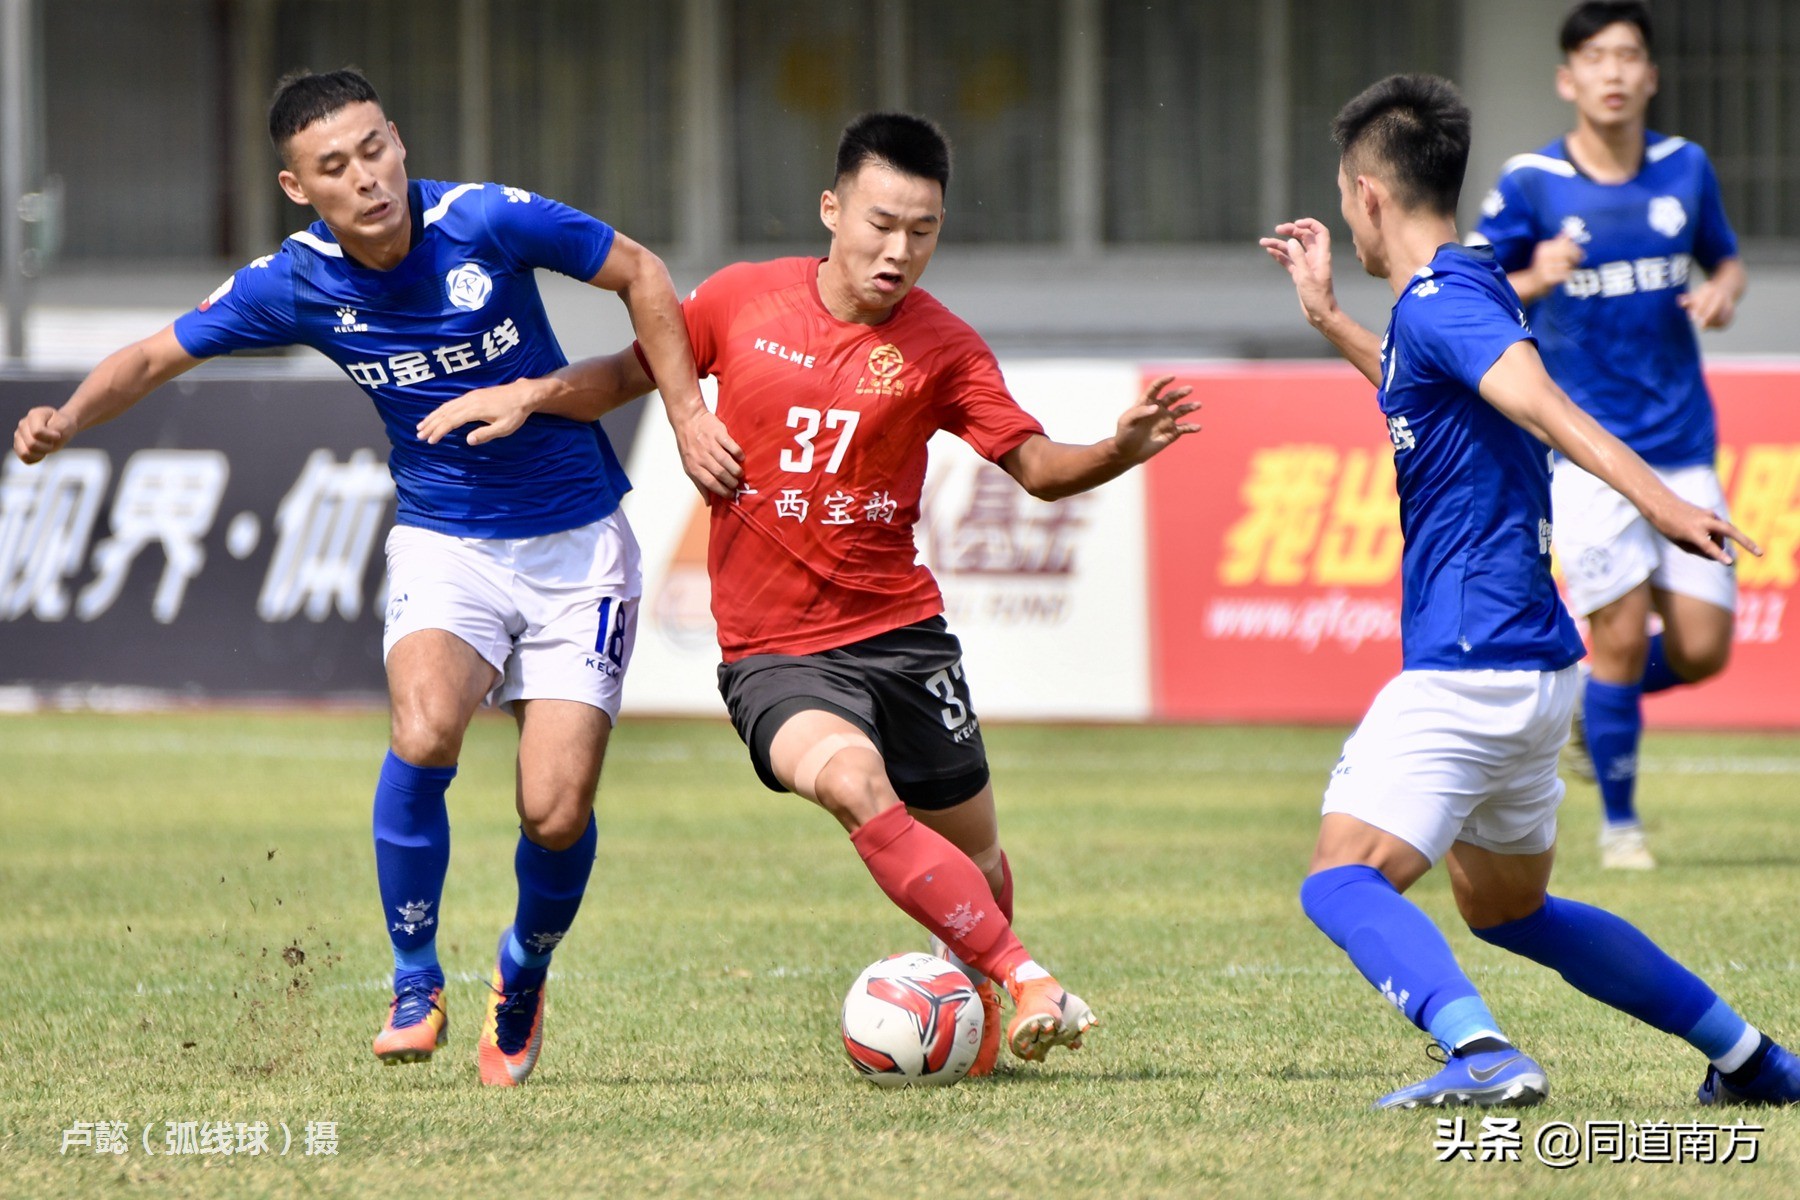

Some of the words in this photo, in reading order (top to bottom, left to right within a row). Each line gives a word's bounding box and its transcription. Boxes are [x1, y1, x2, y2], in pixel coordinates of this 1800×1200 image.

[334, 324, 368, 333] KELME
[346, 317, 521, 389] 中金在线
[754, 338, 816, 369] KELME
[779, 406, 861, 474] 37
[735, 482, 898, 525] 广西宝韵
[595, 597, 626, 668] 18
